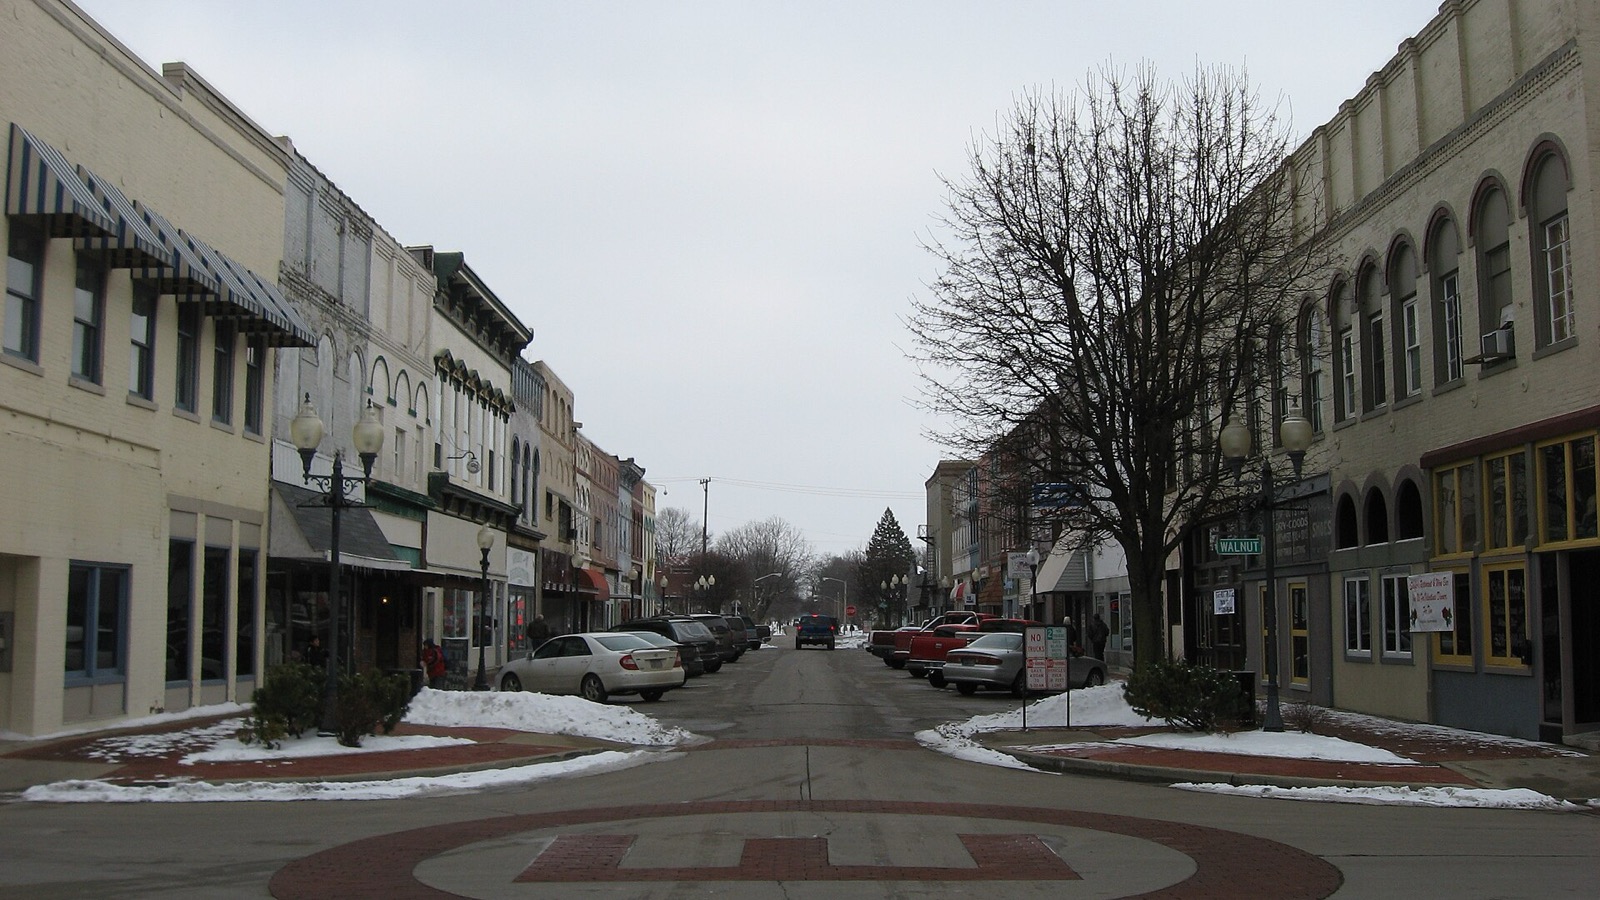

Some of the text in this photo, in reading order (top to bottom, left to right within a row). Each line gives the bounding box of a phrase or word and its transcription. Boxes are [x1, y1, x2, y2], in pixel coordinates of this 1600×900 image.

[1220, 541, 1259, 553] WALNUT
[1030, 634, 1041, 642] NO
[1047, 629, 1053, 638] 2
